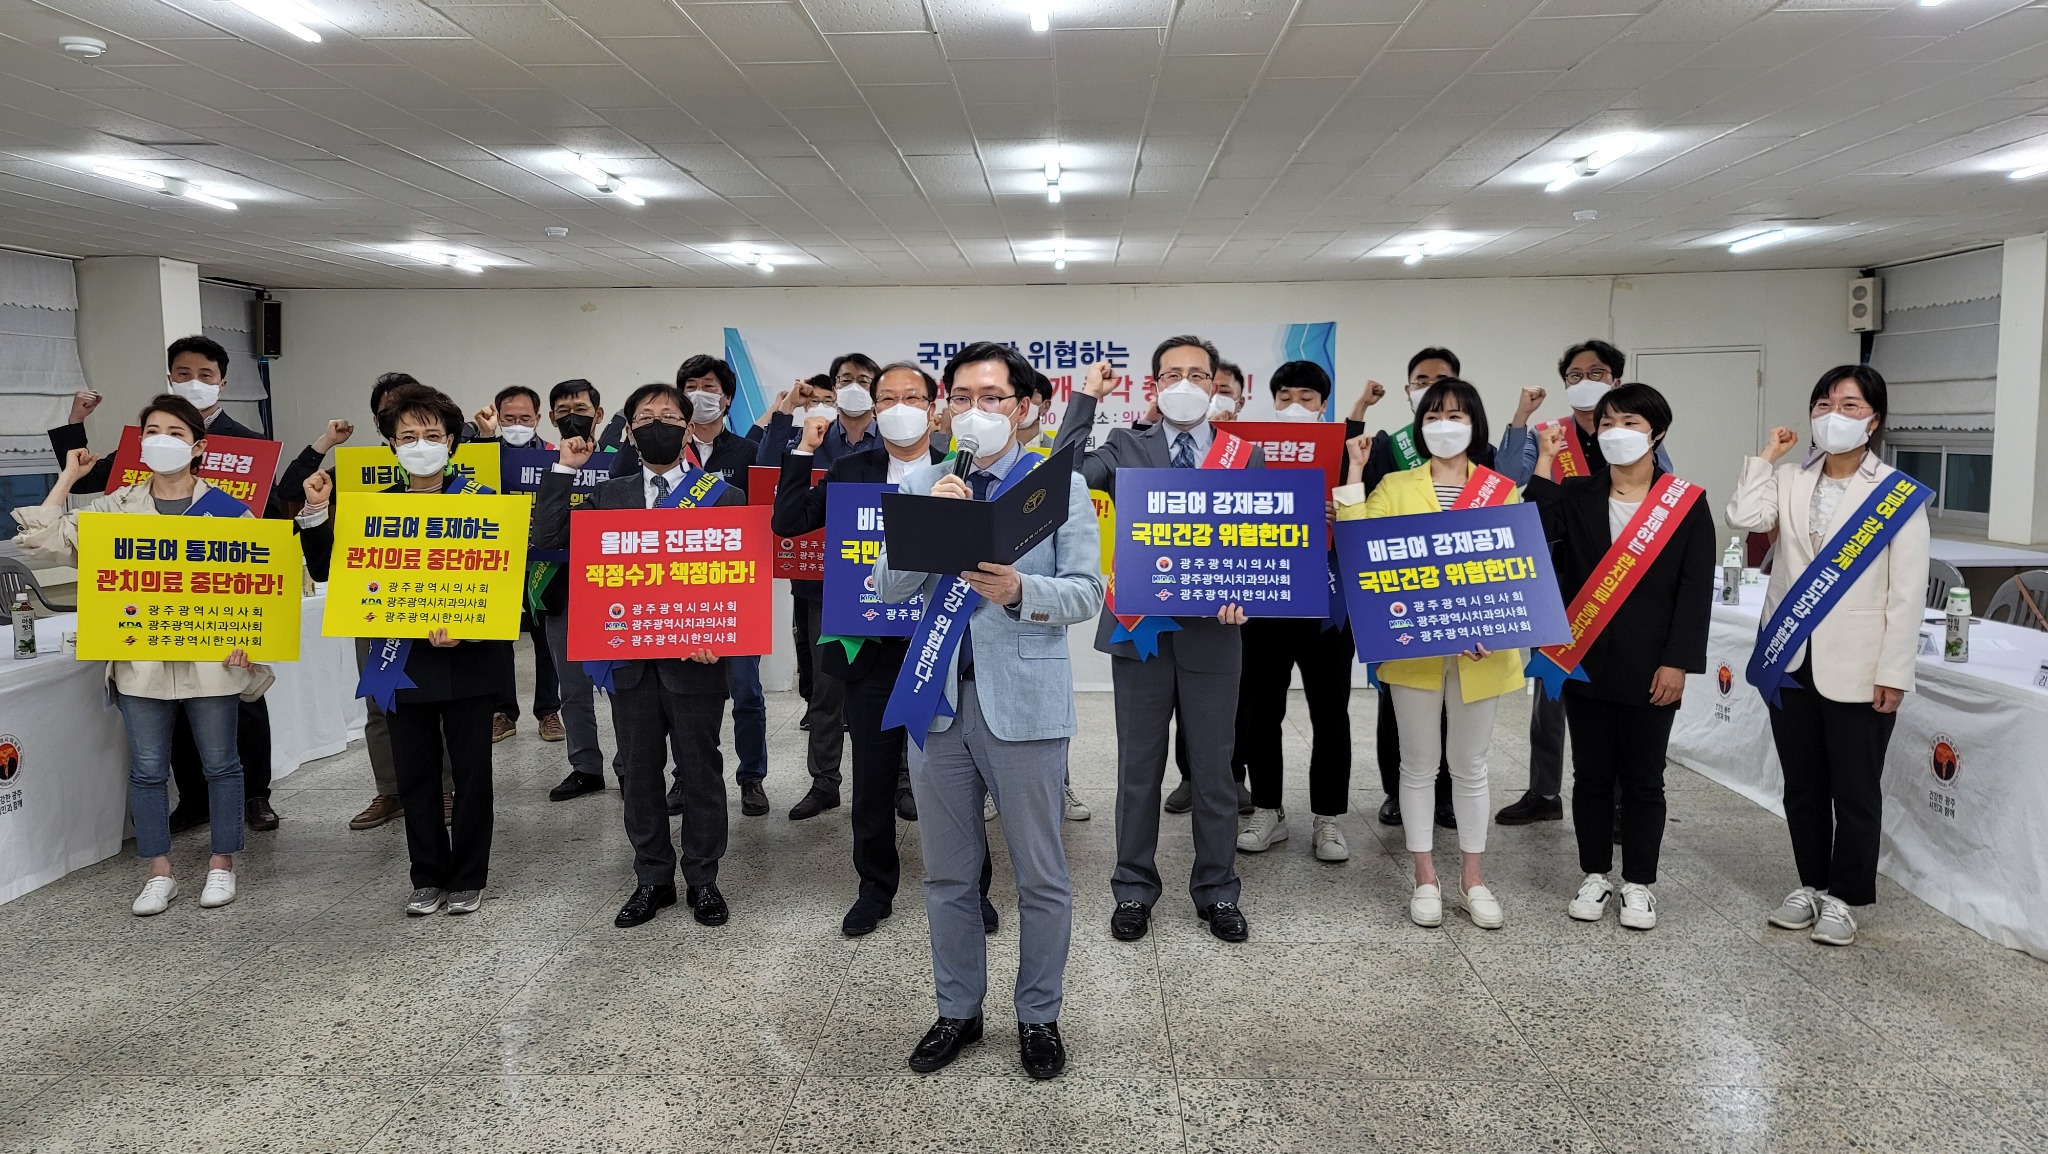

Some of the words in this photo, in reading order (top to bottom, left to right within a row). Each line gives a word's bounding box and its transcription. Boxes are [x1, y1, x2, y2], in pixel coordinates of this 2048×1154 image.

[1028, 340, 1129, 370] 위협하는
[1148, 491, 1206, 514] 비급여
[1213, 491, 1294, 515] 강제공개
[1875, 479, 1917, 519] 비급여
[364, 516, 419, 538] 비급여
[425, 517, 500, 539] 통제하는
[1131, 522, 1213, 546] 국민건강
[1218, 523, 1309, 548] 위협한다!
[1627, 505, 1669, 555] 통제하는
[114, 538, 178, 560] 비급여
[185, 539, 270, 563] 통제하는
[601, 530, 660, 555] 올바른
[665, 528, 742, 553] 진료환경
[1367, 535, 1429, 562] 비급여
[1432, 527, 1515, 556] 강제공개
[1831, 515, 1884, 571] 강제공개
[346, 547, 420, 570] 관치의료
[427, 548, 509, 571] 중단하라!
[1179, 558, 1290, 570] 광주광역시의사회
[97, 569, 183, 593] 관치의료
[190, 571, 284, 595] 중단하라!
[585, 563, 665, 588] 적정수가
[669, 560, 756, 585] 책정하라!
[1179, 574, 1291, 586] 광주광역시치과의사회
[1358, 566, 1439, 593] 국민건강
[1445, 556, 1537, 586] 위협한다!
[1592, 552, 1637, 604] 관치의료
[388, 582, 489, 594] 광주광역시의사회
[1179, 589, 1292, 601] 광주광역시한의사회
[1797, 566, 1840, 619] 국민건강
[148, 605, 263, 617] 광주광역시의사회
[387, 597, 487, 608] 광주광역시치과의사회
[631, 601, 737, 615] 광주광역시의사회
[1413, 591, 1523, 613] 광주광역시의사회
[118, 621, 142, 629] KDA
[147, 620, 262, 631] 광주광역시치과의사회
[385, 612, 486, 624] 광주광역시한의사회
[631, 617, 737, 630] 광주광역시치과의사회
[1416, 606, 1528, 627] 광주광역시치과의사회
[147, 635, 262, 646] 광주광역시한의사회
[631, 632, 737, 646] 광주광역시한의사회
[1419, 620, 1532, 642] 광주광역시한의사회
[1762, 616, 1799, 669] 위협한다!
[914, 614, 952, 693] 위협한다!
